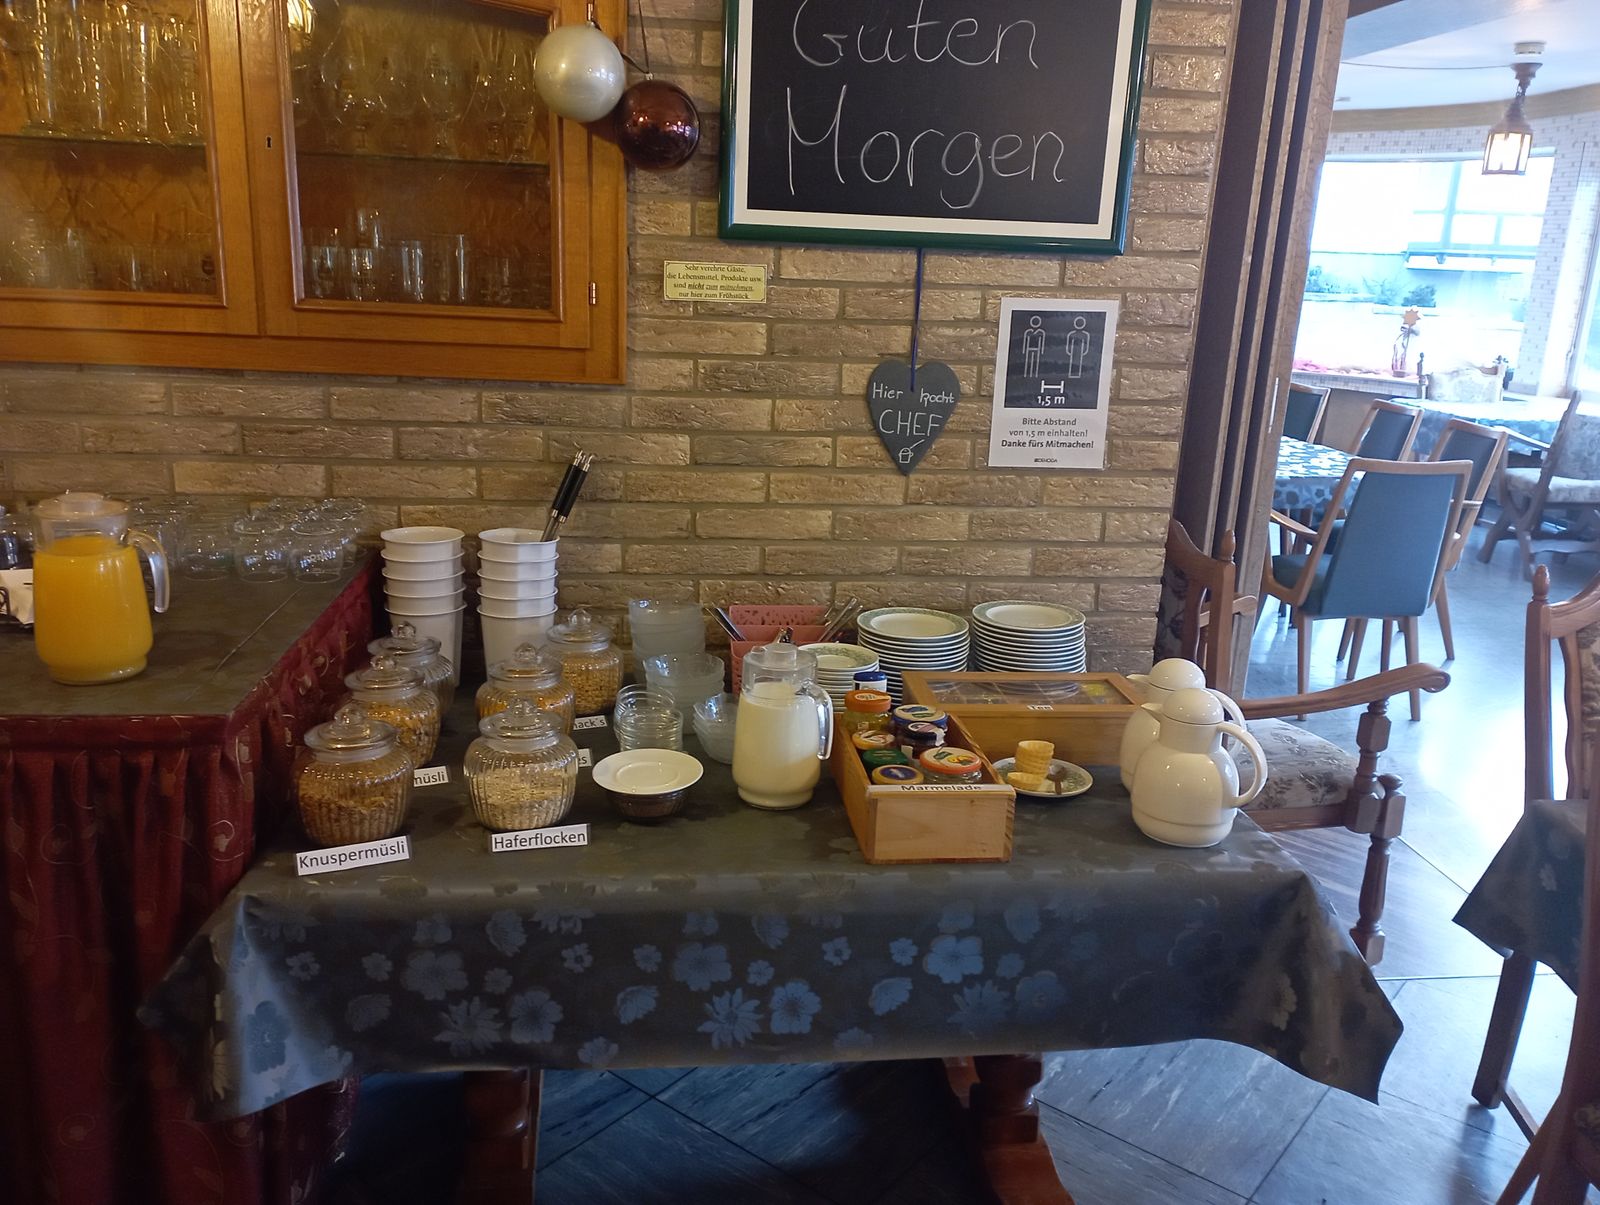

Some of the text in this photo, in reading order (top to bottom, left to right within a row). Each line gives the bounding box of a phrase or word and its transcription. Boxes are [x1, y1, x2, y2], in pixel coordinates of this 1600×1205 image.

[793, 0, 1039, 69] Guten
[787, 85, 1067, 209] Morgen
[691, 291, 703, 299] hier
[872, 381, 904, 400] Hier
[1037, 396, 1065, 405] 1,5 m
[878, 409, 943, 437] CHEF
[1022, 418, 1077, 426] Bitte Abstand
[1025, 430, 1036, 438] 1,5
[1047, 429, 1088, 438] einhalten!
[1028, 440, 1044, 448] fürs
[1045, 440, 1094, 449] Mitmachen!
[901, 784, 982, 792] Marmelade
[494, 831, 586, 850] Haferflocken
[299, 841, 405, 869] Knuspermüsli
